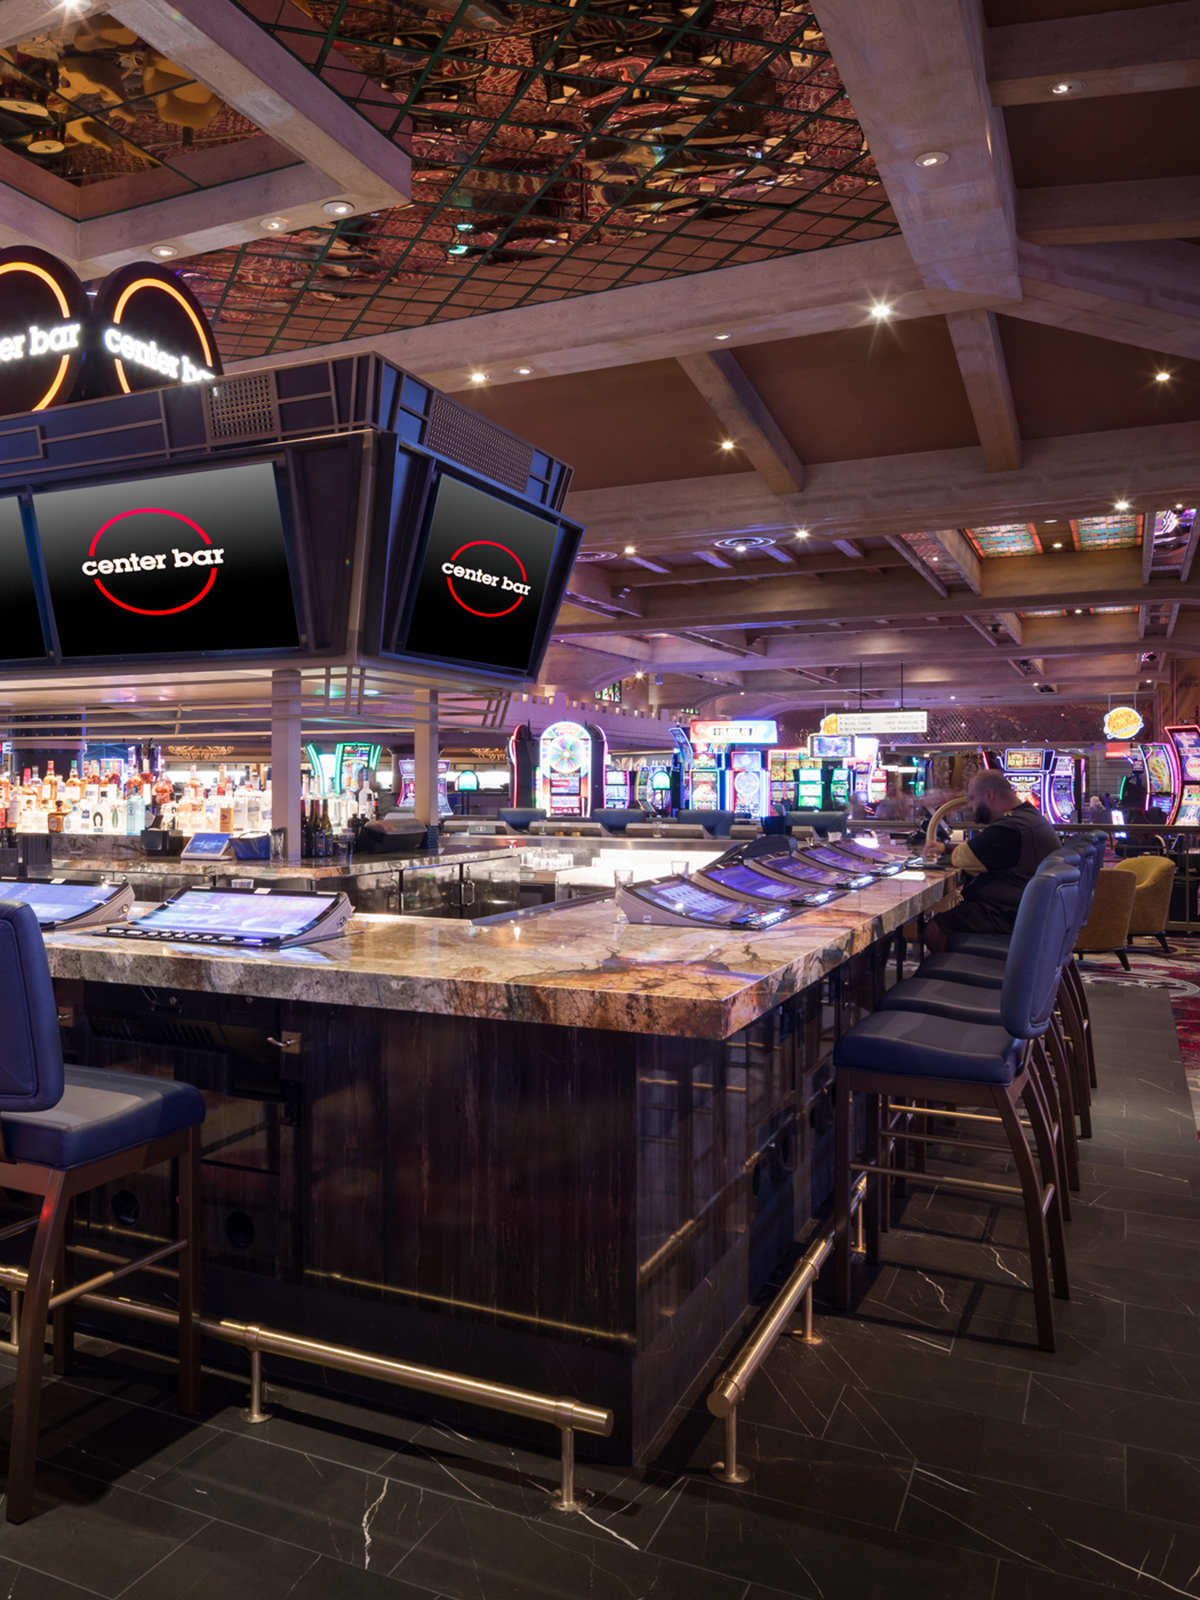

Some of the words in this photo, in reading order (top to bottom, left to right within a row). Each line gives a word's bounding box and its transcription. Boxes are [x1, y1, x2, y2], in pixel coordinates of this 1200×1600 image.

[29, 323, 81, 350] bar
[104, 328, 179, 379] center
[181, 356, 215, 384] ba
[81, 552, 167, 576] center
[172, 548, 225, 568] bar
[441, 562, 500, 587] center
[502, 575, 532, 596] bar
